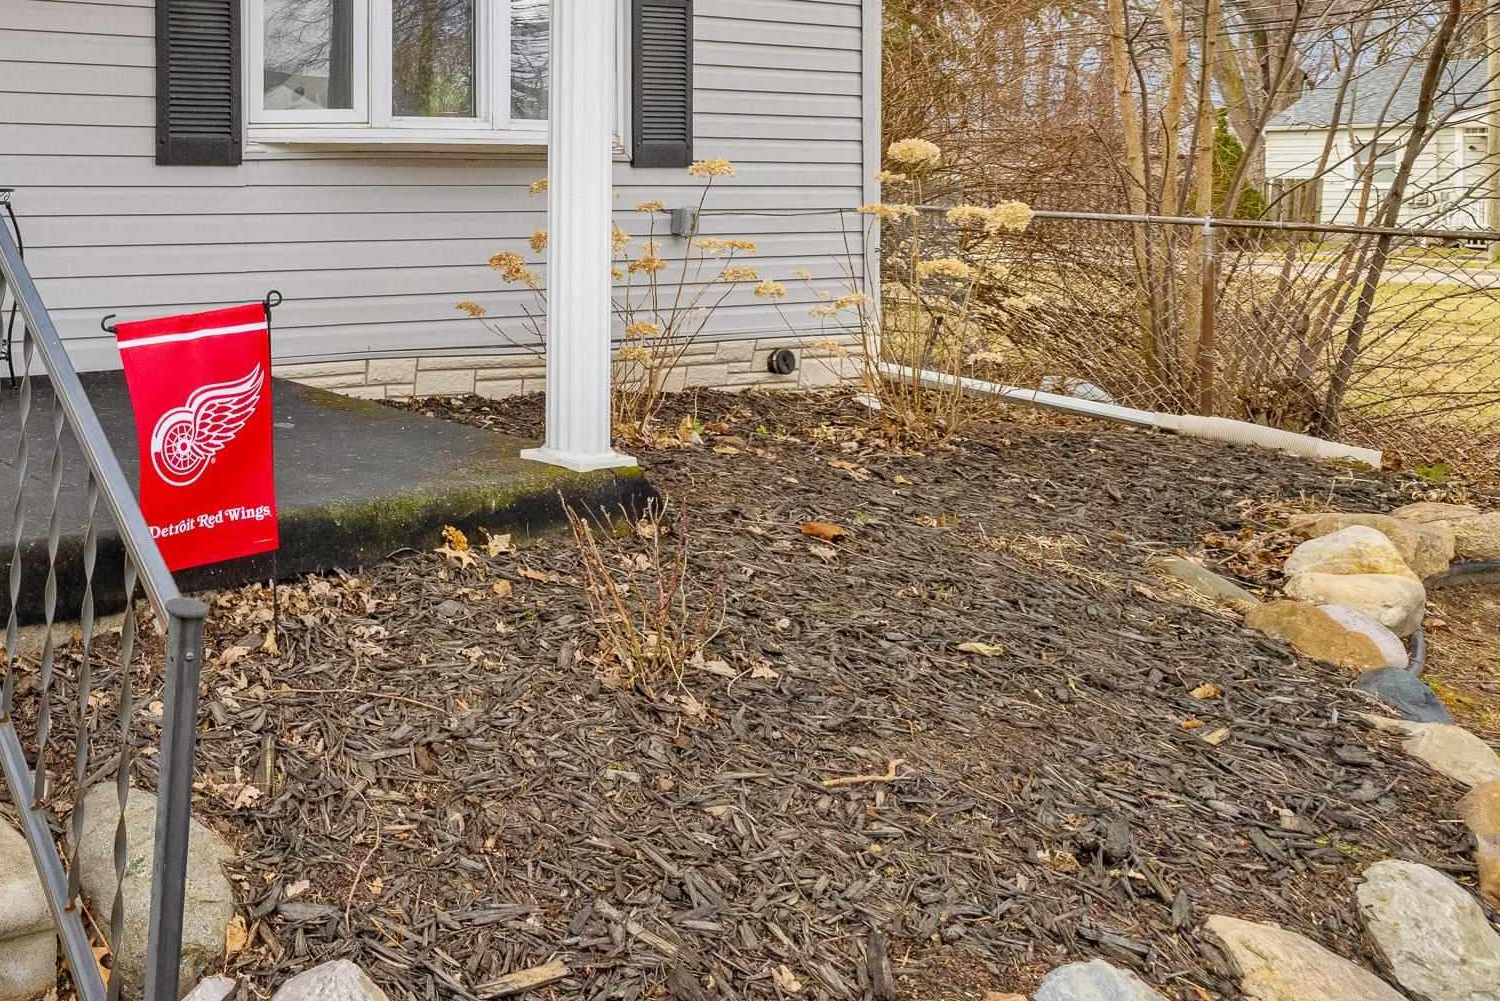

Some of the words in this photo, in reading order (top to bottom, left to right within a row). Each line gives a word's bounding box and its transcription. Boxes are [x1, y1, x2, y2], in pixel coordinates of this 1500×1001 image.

[148, 519, 195, 539] Detroit
[197, 511, 223, 528] Red
[225, 505, 270, 520] Wings
